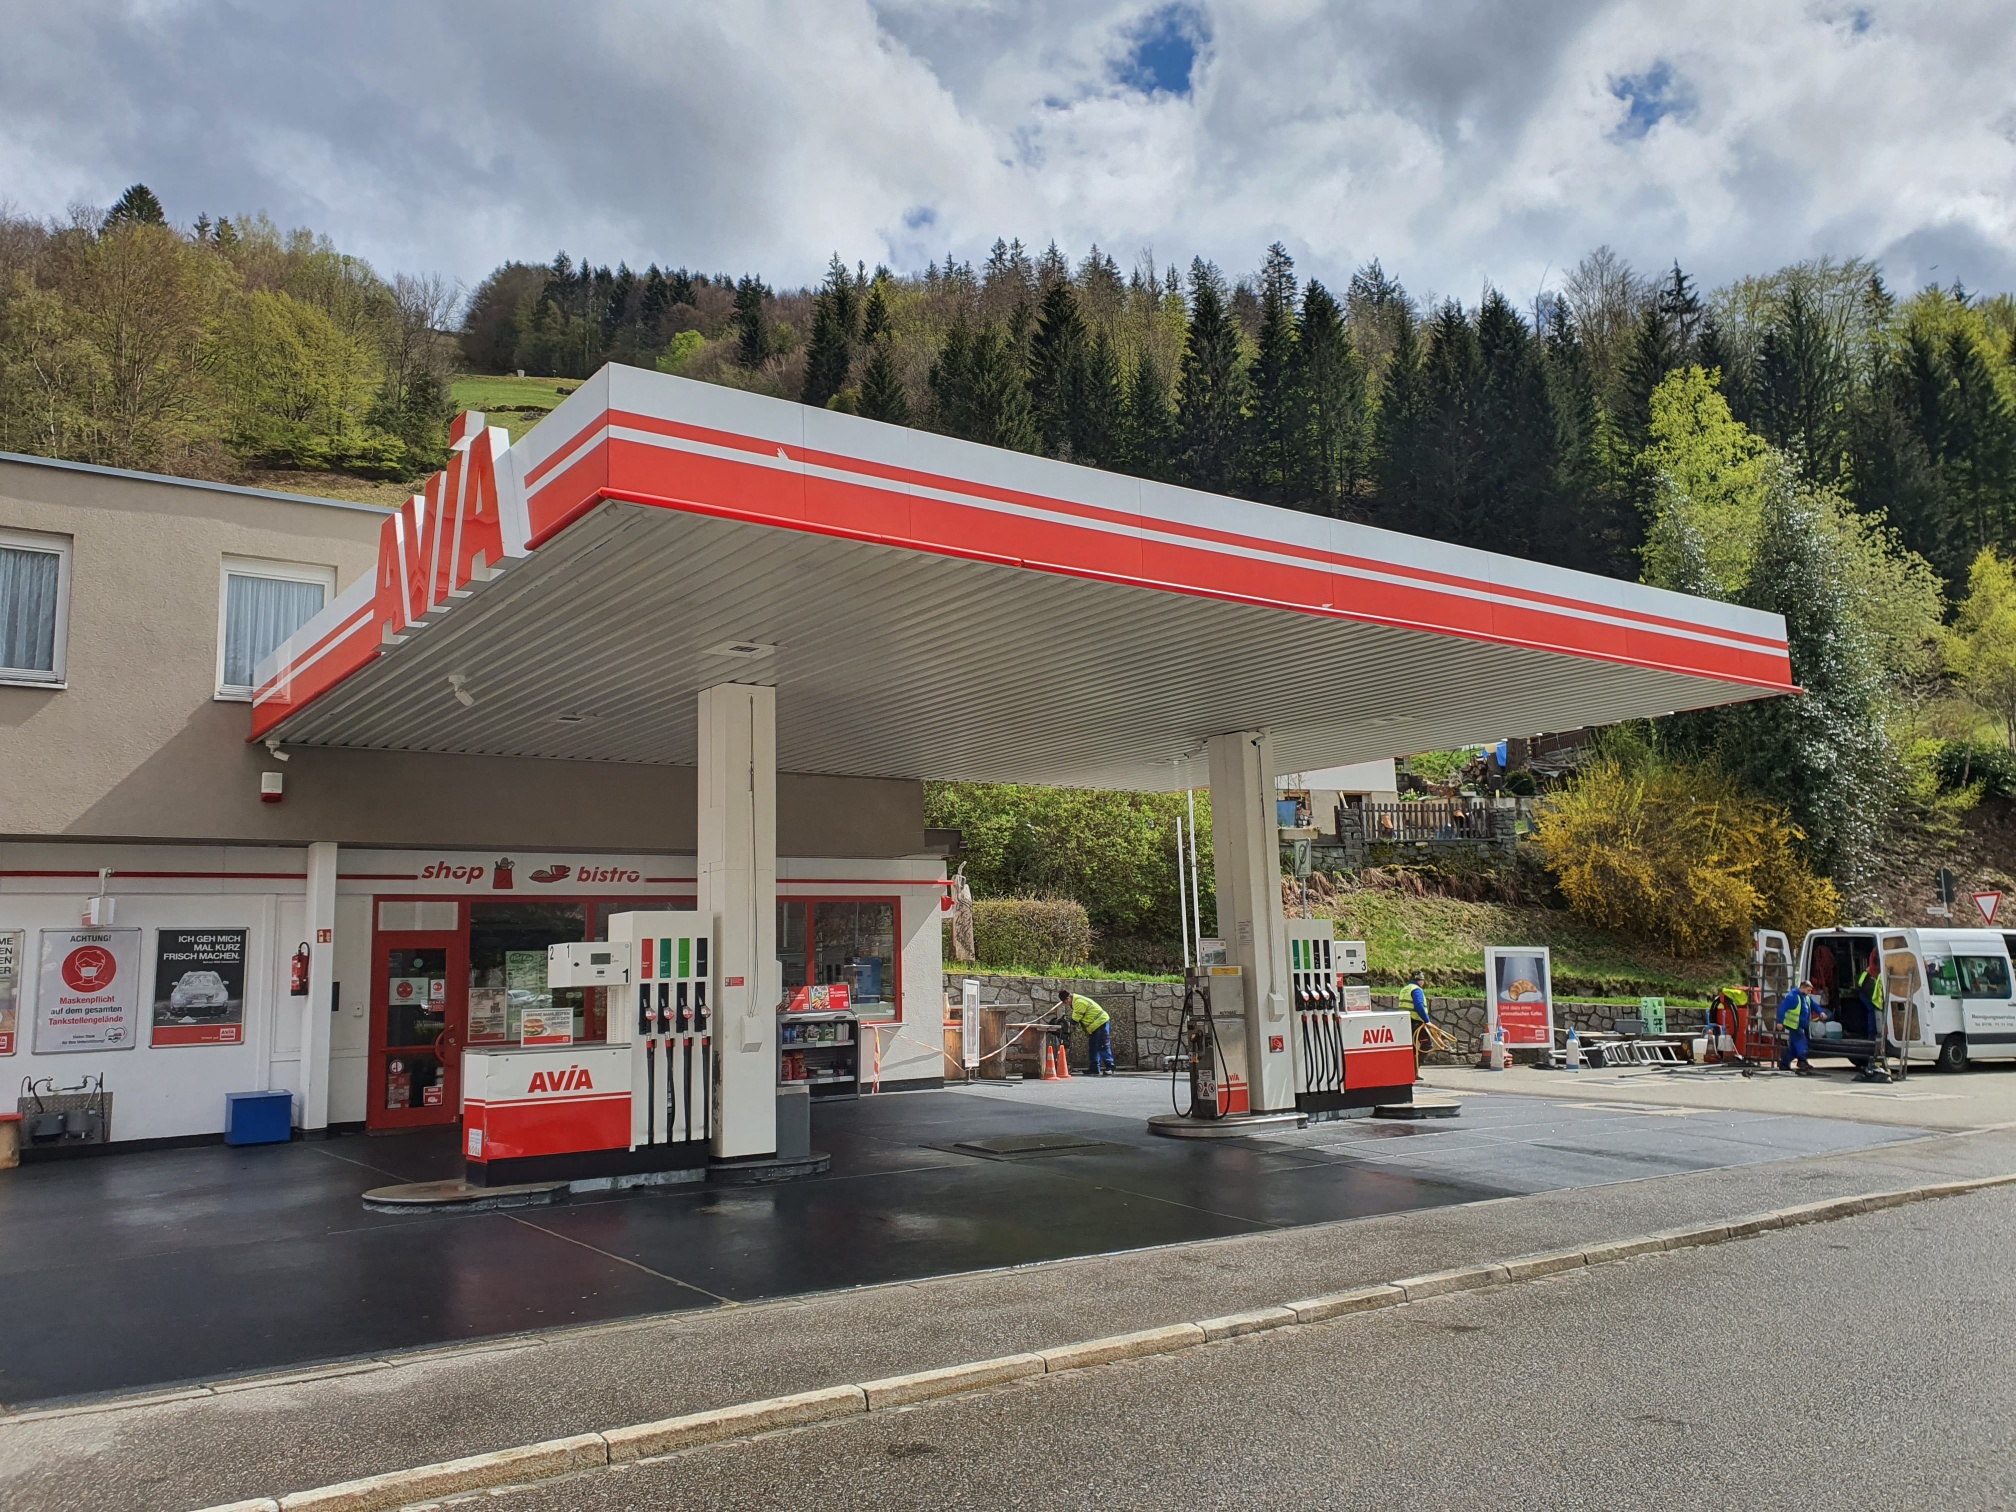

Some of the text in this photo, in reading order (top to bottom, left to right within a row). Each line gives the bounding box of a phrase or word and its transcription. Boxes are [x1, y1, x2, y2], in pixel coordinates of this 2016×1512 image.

[421, 860, 484, 885] shop
[577, 866, 641, 883] bistro
[69, 934, 112, 943] ACHTUNG!
[178, 935, 241, 943] ICH GEH MICH
[193, 943, 241, 952] MAL KURZ
[549, 945, 554, 961] 2
[566, 944, 570, 959] 1
[163, 952, 241, 961] FRISCH MACHEN.
[1361, 960, 1367, 971] 3
[622, 968, 629, 984] 1
[59, 995, 115, 1005] Maskenpflicht
[50, 1006, 123, 1016] auf dem gesamten
[48, 1015, 124, 1026] Tankstellengelände
